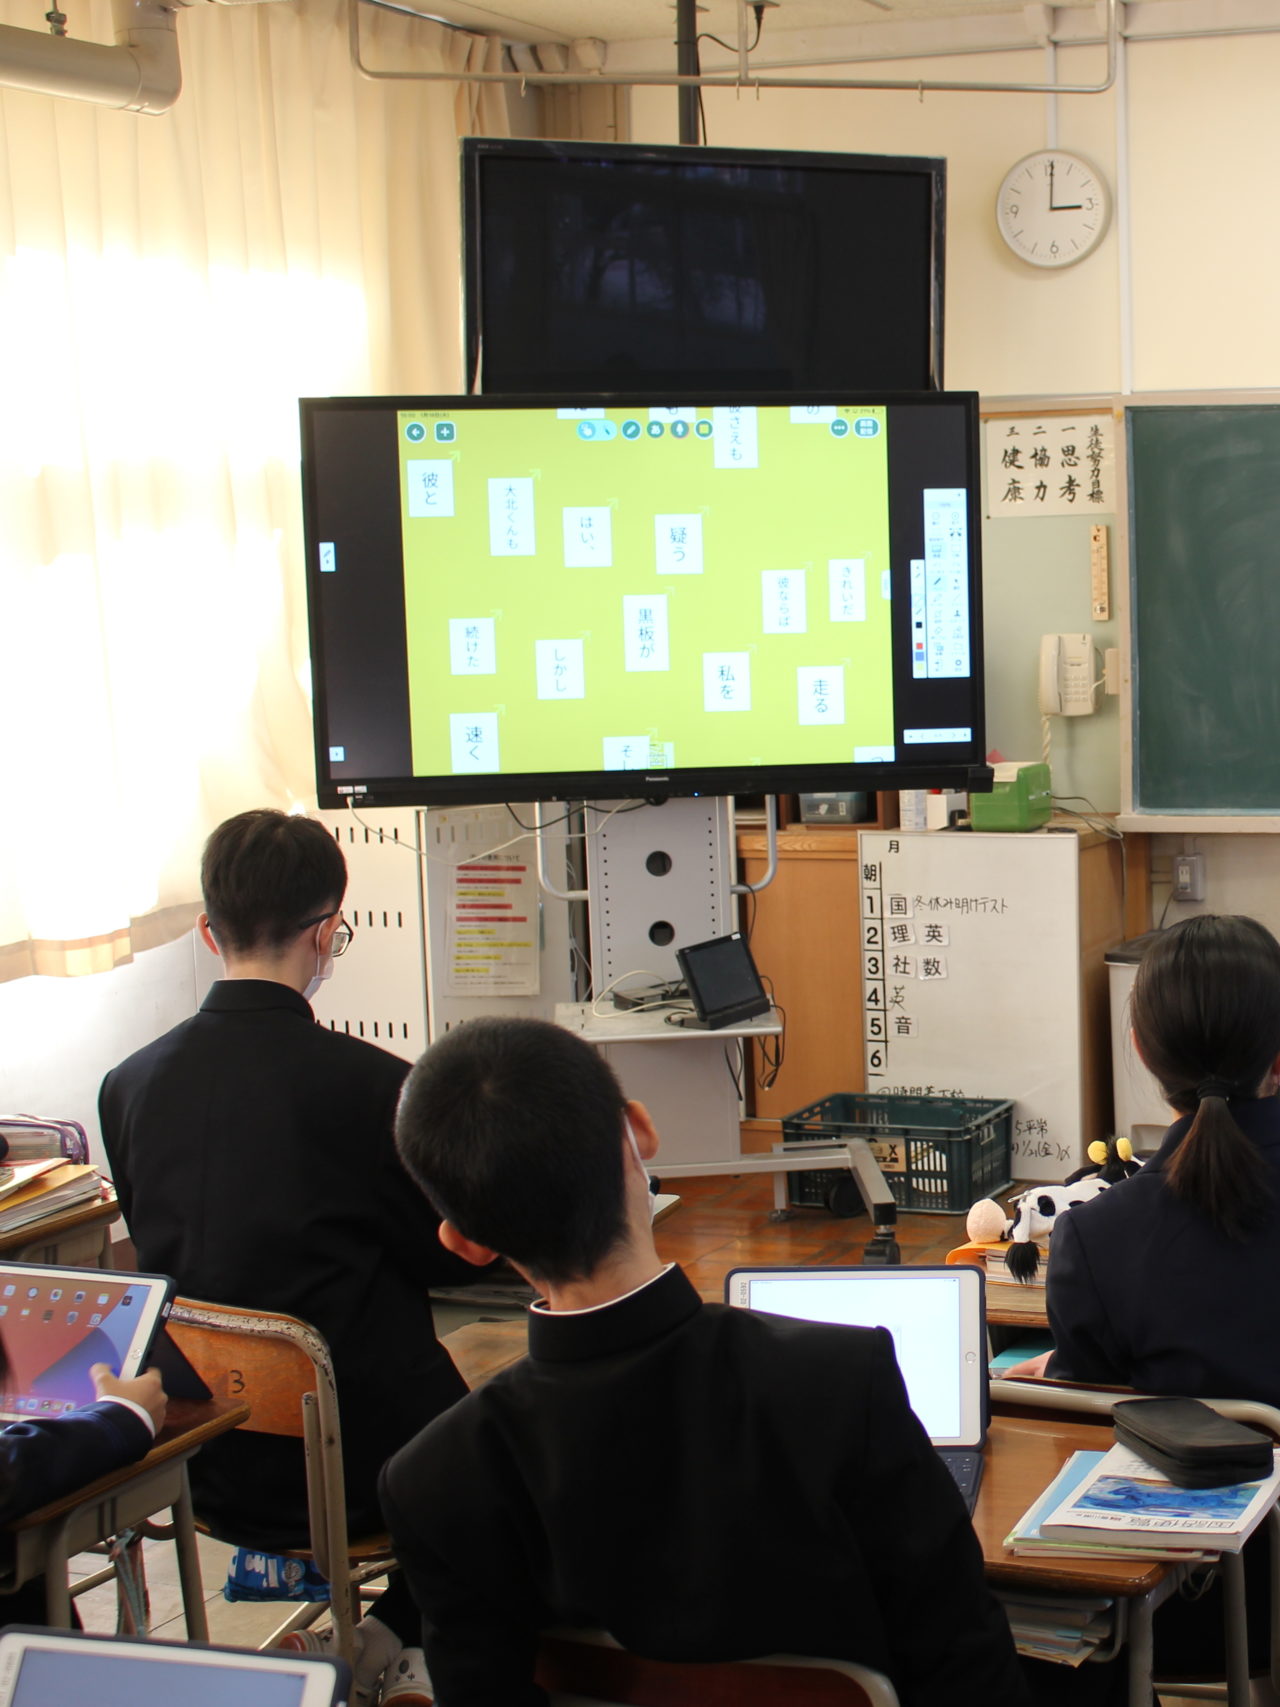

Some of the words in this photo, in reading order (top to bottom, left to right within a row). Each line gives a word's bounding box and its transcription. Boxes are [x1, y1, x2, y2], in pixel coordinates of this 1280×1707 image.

[1010, 204, 1019, 218] 9
[1085, 198, 1094, 211] 3
[1050, 240, 1059, 254] 6
[1002, 446, 1024, 502] 健康
[1030, 446, 1050, 502] 協力
[1059, 444, 1081, 503] 思考
[421, 472, 439, 506] 彼と
[669, 526, 689, 562] 疑う
[777, 576, 791, 627] 彼ならば
[465, 625, 480, 668] 続けた
[638, 607, 656, 659] 黒板が
[553, 648, 568, 693] しかし
[718, 664, 735, 701] 私を
[812, 678, 830, 714] 走る
[465, 725, 483, 762] 速く
[888, 840, 900, 854] 月
[863, 864, 878, 882] 朝
[866, 896, 875, 914] 1
[889, 896, 908, 916] 国
[866, 927, 879, 945] 2
[890, 924, 911, 944] 理
[924, 924, 944, 944] 英
[868, 957, 880, 976] 3
[892, 956, 911, 976] 社
[922, 957, 943, 977] 数
[866, 988, 881, 1006] 4
[870, 1018, 882, 1036] 5
[894, 1016, 912, 1036] 音
[869, 1051, 882, 1068] 6
[230, 1369, 246, 1393] 3
